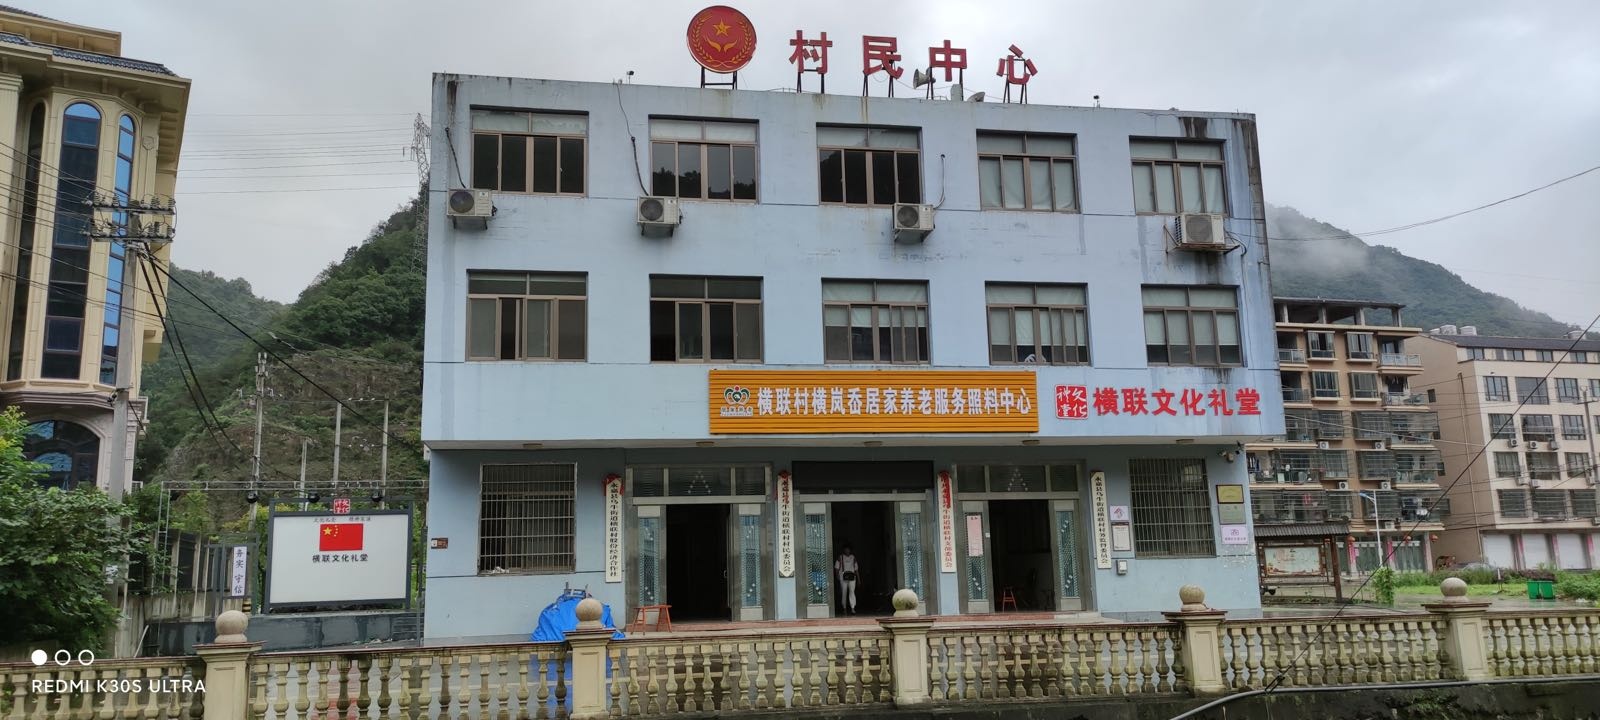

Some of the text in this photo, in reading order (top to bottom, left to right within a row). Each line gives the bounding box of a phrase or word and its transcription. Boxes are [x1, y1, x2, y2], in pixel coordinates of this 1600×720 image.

[789, 30, 1038, 85] 村民中心
[757, 386, 1032, 416] 横联村横岚岙居家养老服务照料中心
[1092, 387, 1262, 416] 横联文化礼堂
[312, 553, 369, 563] 横联文化礼堂
